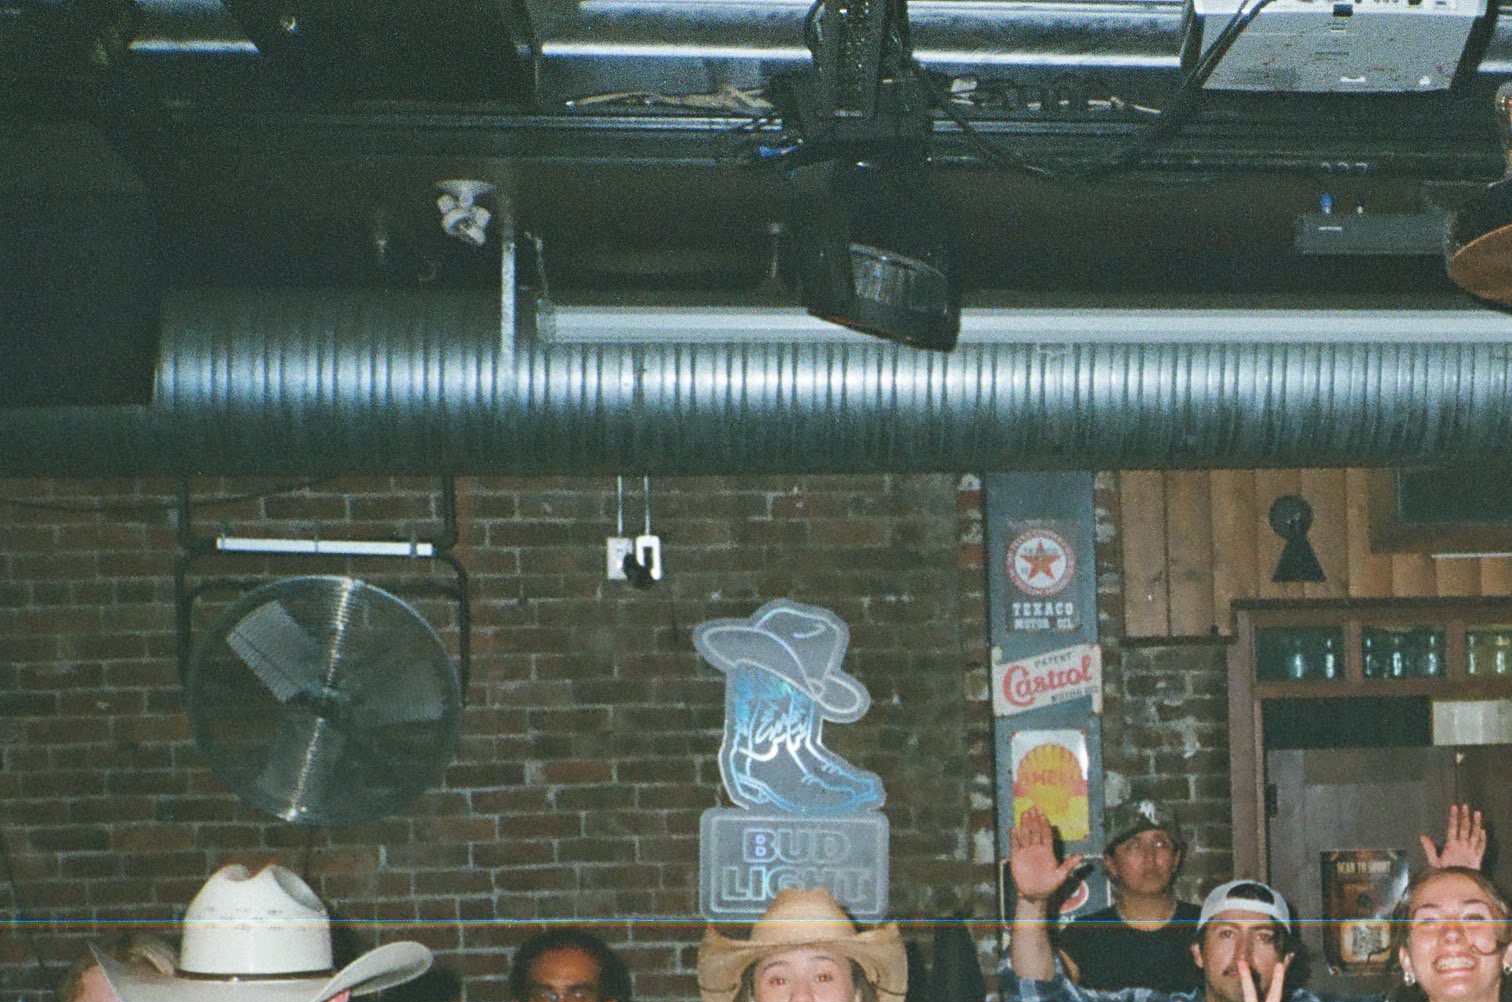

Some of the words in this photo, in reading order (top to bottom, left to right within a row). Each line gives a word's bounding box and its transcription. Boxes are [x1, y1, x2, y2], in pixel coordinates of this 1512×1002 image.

[1012, 602, 1073, 616] TEXACO
[1014, 618, 1050, 630] MOTOR
[1003, 655, 1092, 708] Castrol
[743, 828, 850, 863] BUD
[722, 865, 877, 900] LIGHT
